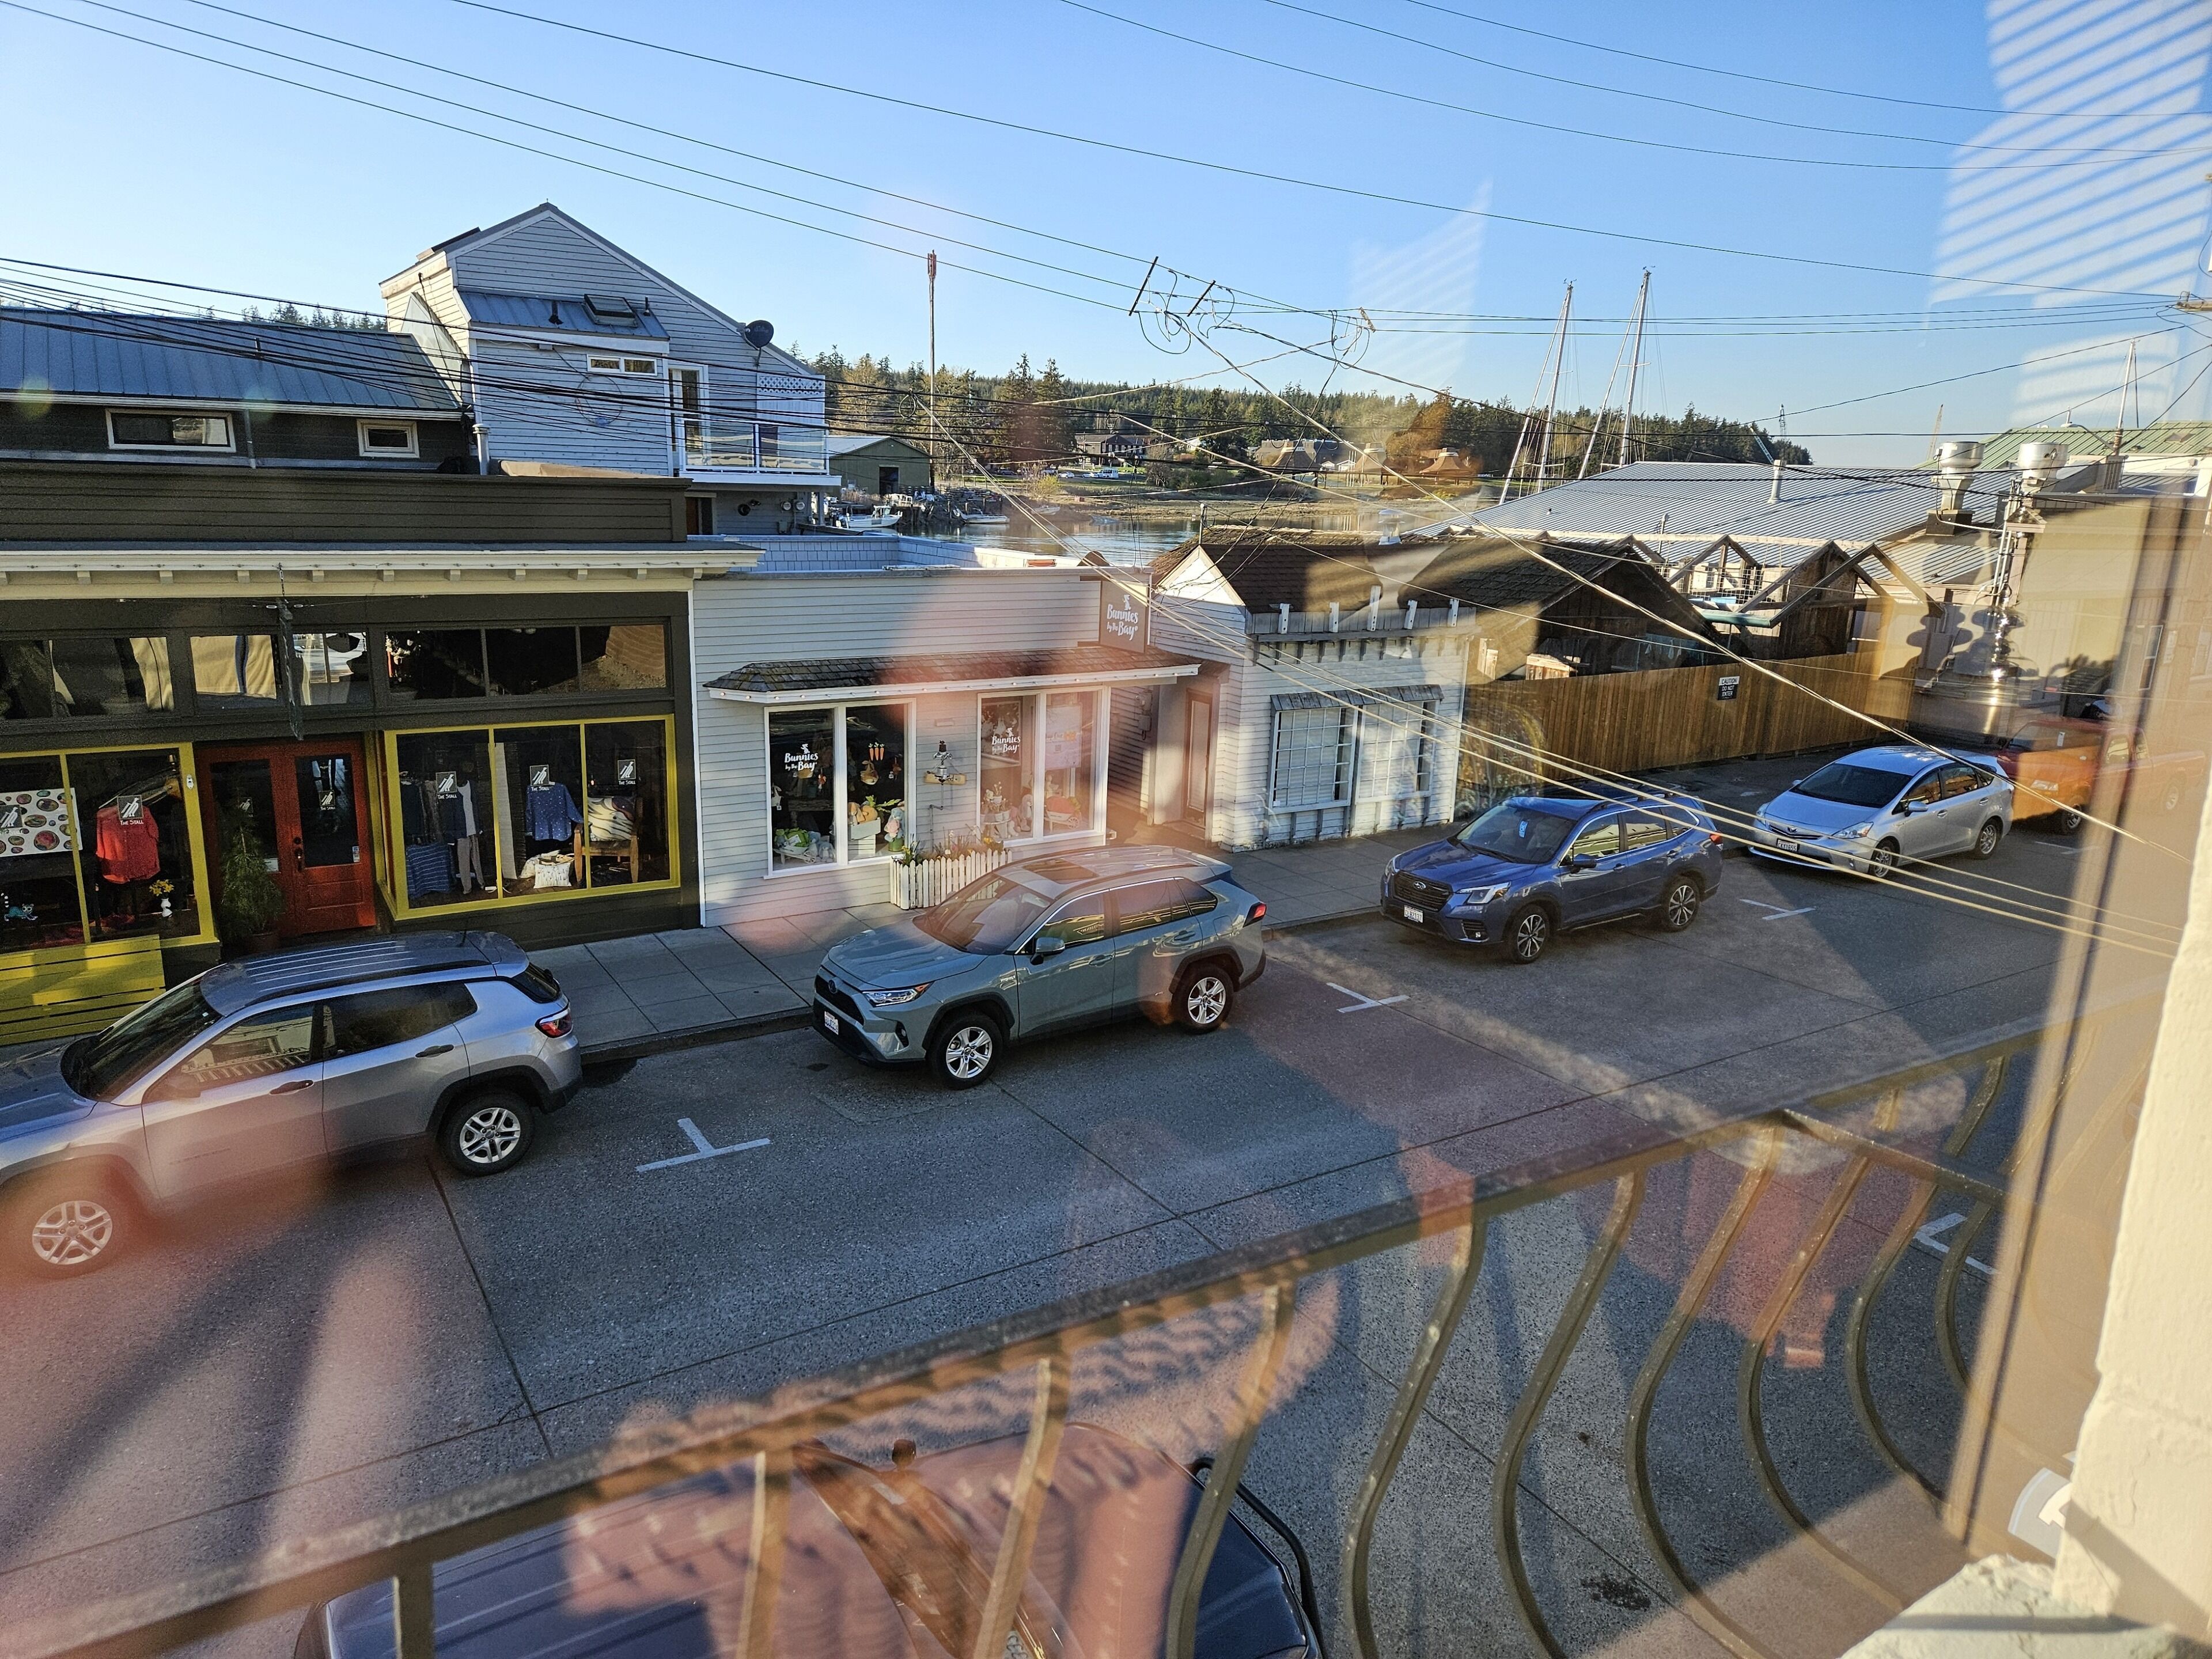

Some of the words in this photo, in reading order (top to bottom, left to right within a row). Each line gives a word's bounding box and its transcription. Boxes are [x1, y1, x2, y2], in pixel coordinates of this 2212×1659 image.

[1107, 604, 1138, 623] Bunnies
[1107, 622, 1112, 632] by
[992, 736, 1021, 745] Bunnies
[785, 753, 819, 763] Bunnies
